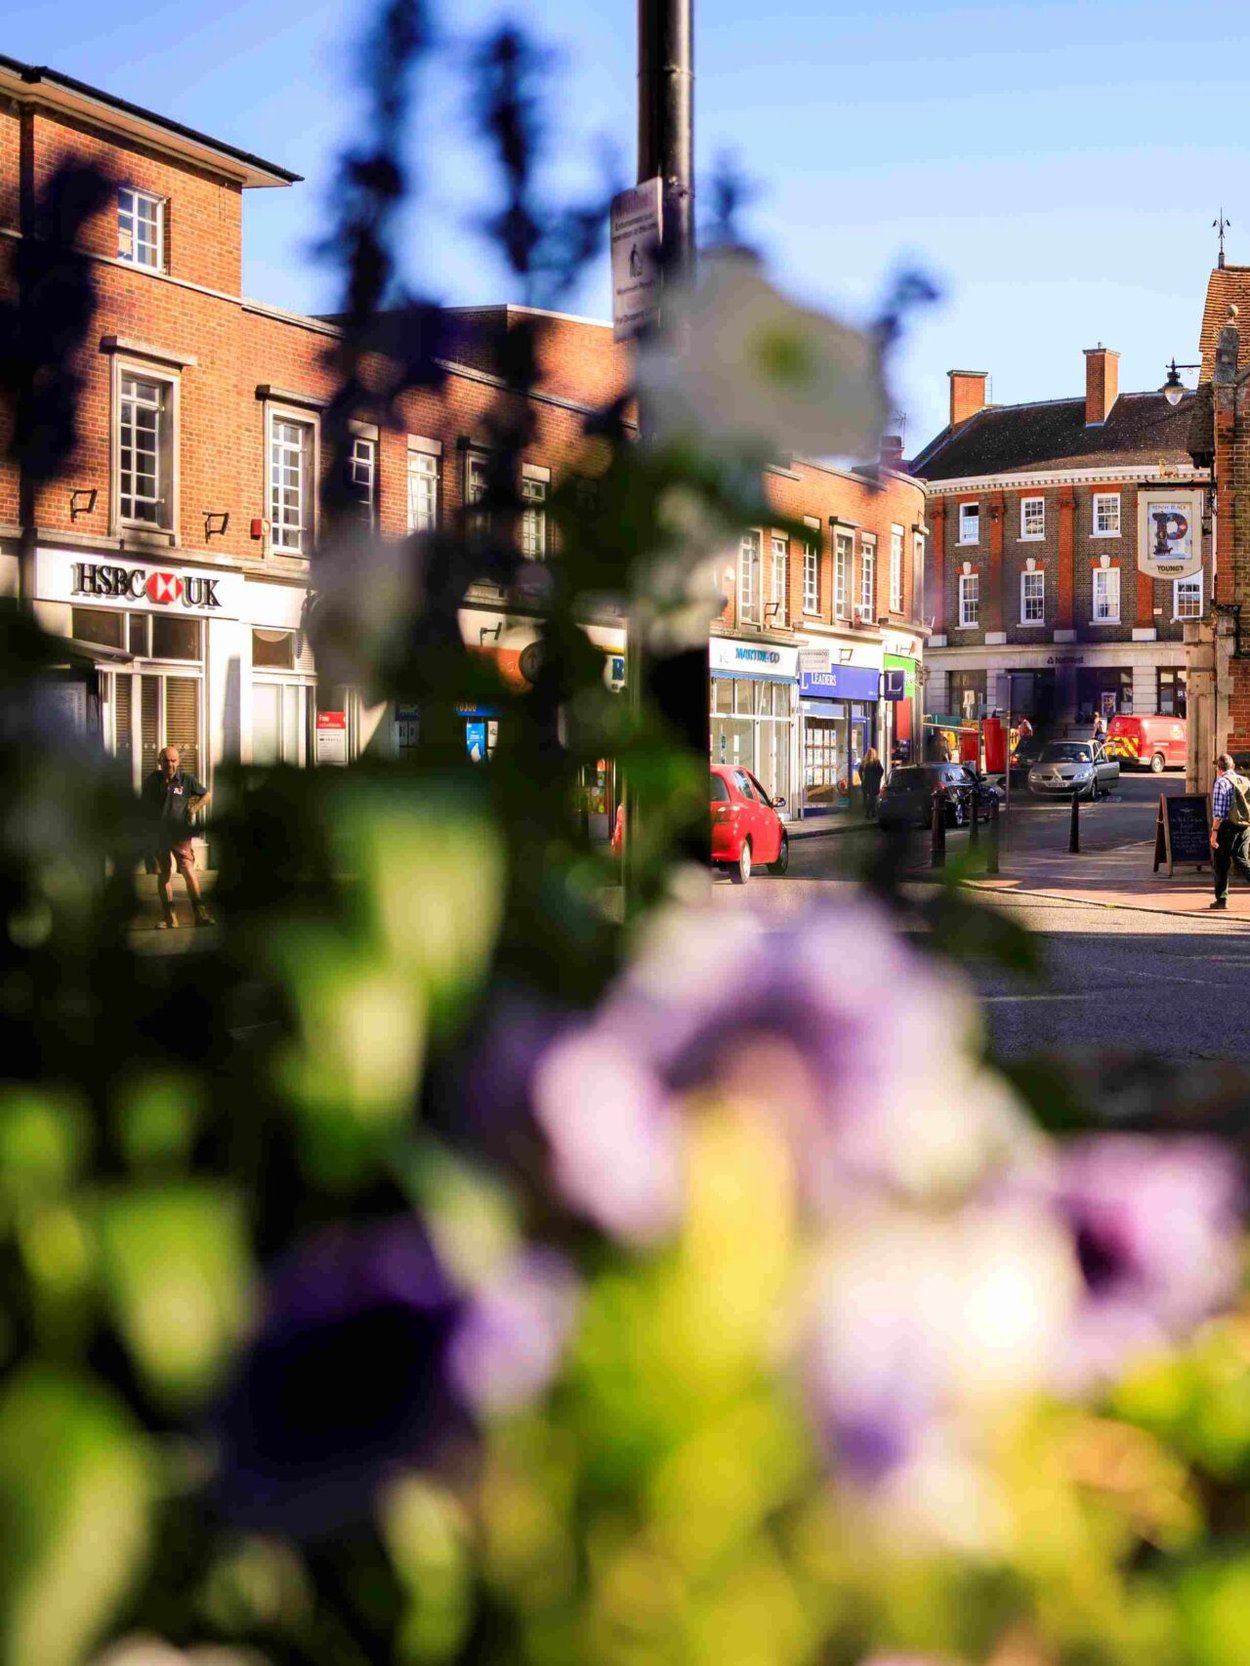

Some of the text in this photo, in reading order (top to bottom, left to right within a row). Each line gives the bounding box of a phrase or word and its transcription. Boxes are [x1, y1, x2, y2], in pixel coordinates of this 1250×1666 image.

[74, 562, 222, 607] HSBC UK
[811, 672, 837, 687] LEADERS
[886, 672, 903, 692] L
